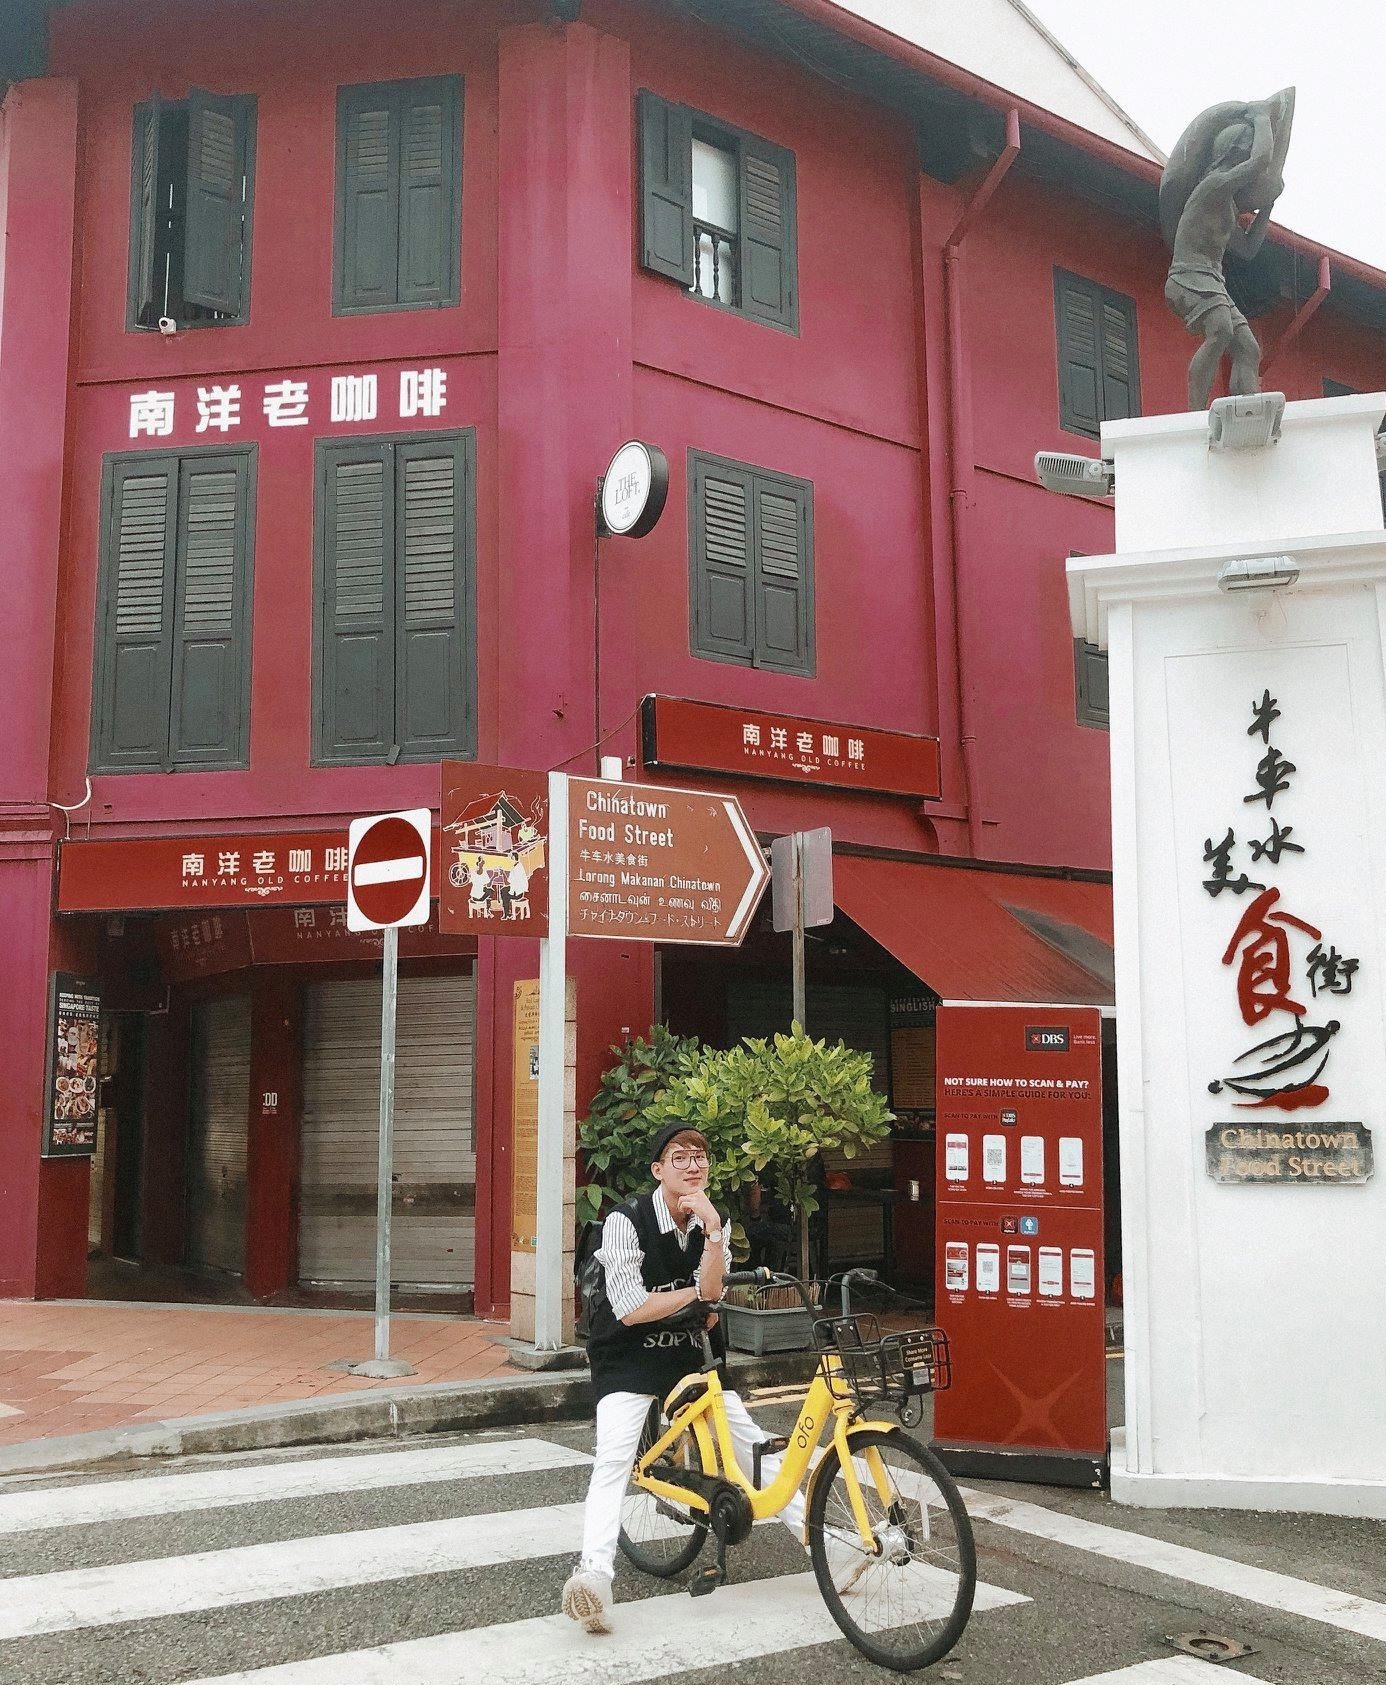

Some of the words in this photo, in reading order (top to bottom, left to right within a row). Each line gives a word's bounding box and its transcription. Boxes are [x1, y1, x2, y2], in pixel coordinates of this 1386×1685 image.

[129, 368, 447, 438] 南洋老咖啡
[742, 723, 865, 761] 南洋老咖啡
[744, 747, 794, 761] NANYANG
[801, 754, 820, 764] OLD
[827, 759, 866, 771] COFFEE
[586, 790, 667, 819] Chinatown
[579, 818, 615, 842] Food
[624, 824, 674, 848] Street
[181, 846, 348, 877] 南洋老咖啡
[182, 877, 248, 888] NANYANG
[257, 876, 284, 885] OLD
[294, 873, 348, 884] COFFEE
[579, 868, 615, 888] Lorong
[621, 871, 665, 888] Makanan
[670, 876, 721, 892] Chinatown
[1042, 1034, 1064, 1044] DBS
[944, 1077, 964, 1086] NOT
[965, 1078, 988, 1087] SURE
[990, 1078, 1013, 1087] HOW
[1014, 1079, 1028, 1088] TO
[1029, 1079, 1054, 1088] SCAN
[1056, 1080, 1064, 1088] &
[1065, 1080, 1089, 1089] PAY?
[944, 1088, 973, 1097] HERE'S
[975, 1088, 982, 1097] A
[984, 1089, 1016, 1098] SIMPLE
[1018, 1090, 1046, 1099] GUIDE
[1048, 1090, 1066, 1099] FOR
[1220, 1129, 1359, 1149] Chinatown
[1219, 1153, 1282, 1176] Food
[1288, 1156, 1362, 1177] Street
[797, 1416, 814, 1449] ofo
